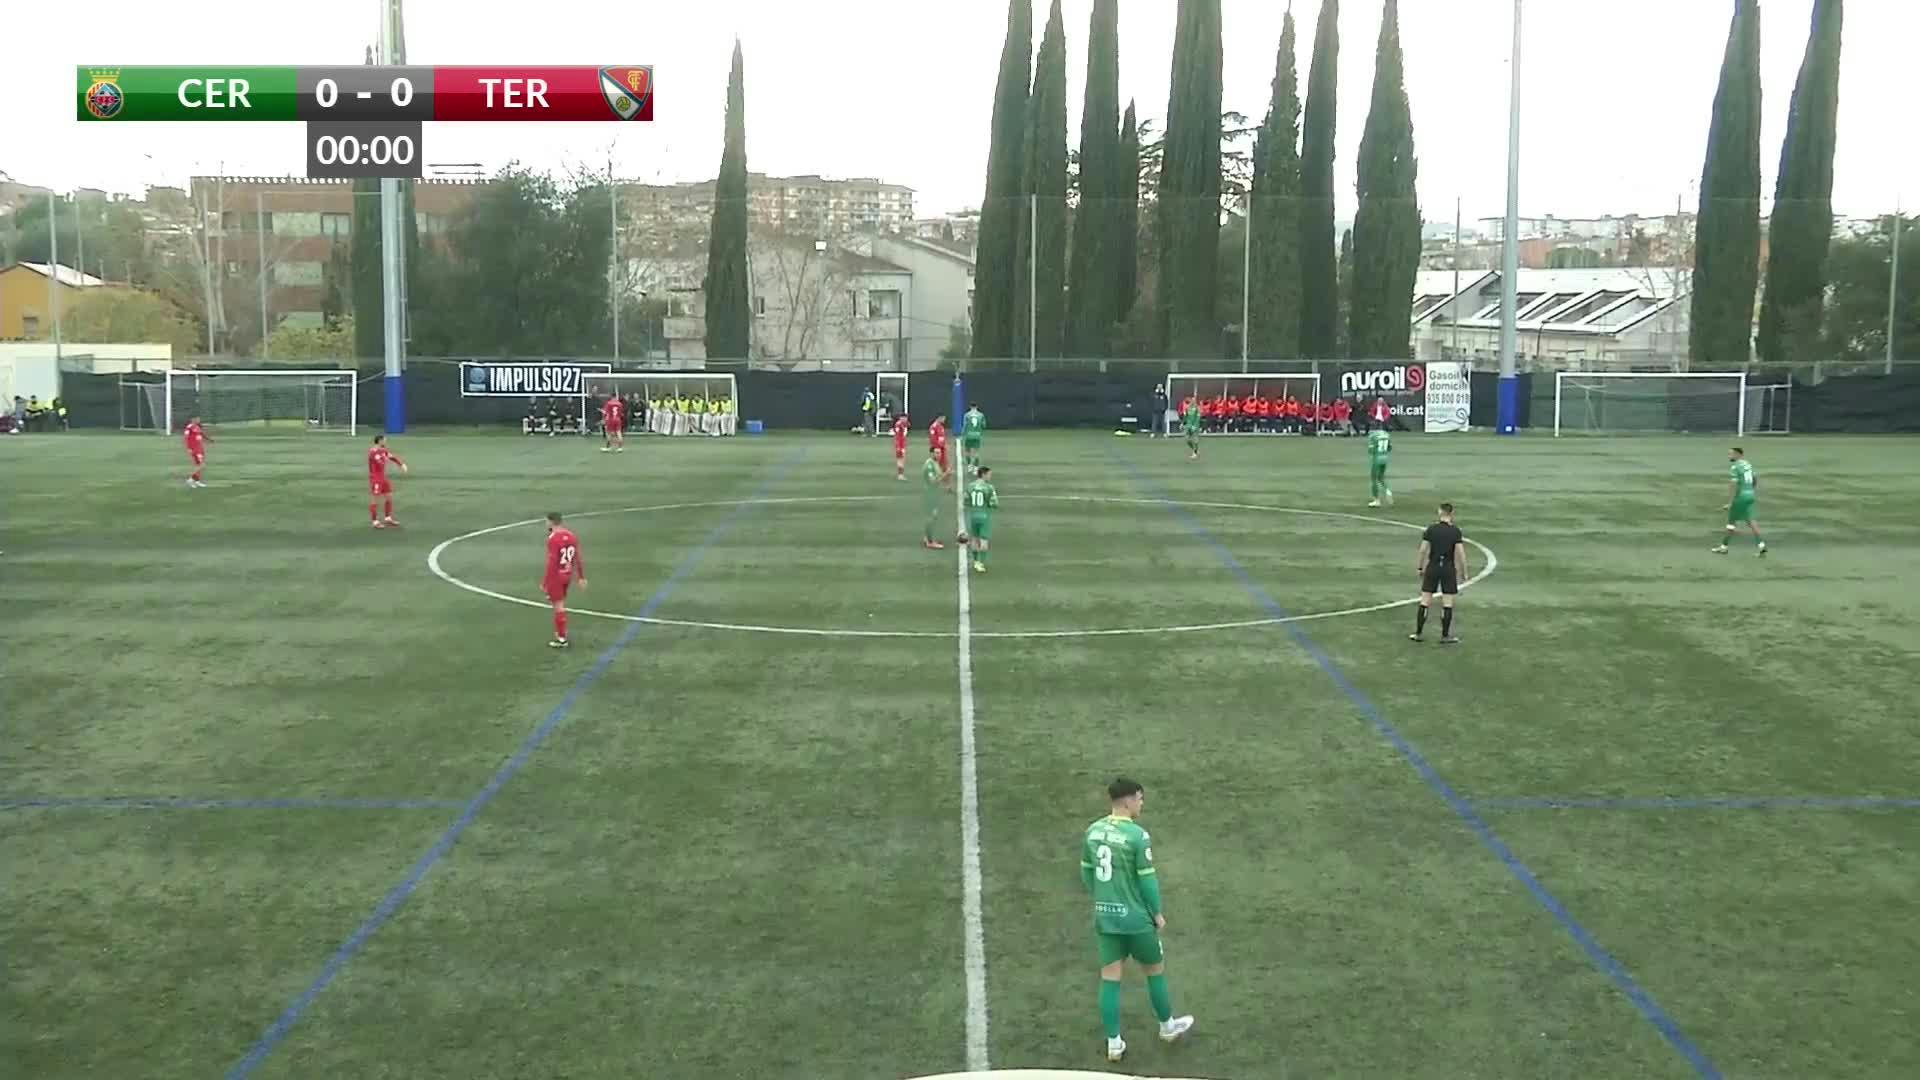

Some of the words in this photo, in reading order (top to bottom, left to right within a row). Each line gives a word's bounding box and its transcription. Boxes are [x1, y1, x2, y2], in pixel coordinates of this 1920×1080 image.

[490, 367, 582, 392] IMPULSO27
[1341, 366, 1406, 391] nuroil
[1429, 370, 1460, 380] Gasoil
[1390, 404, 1424, 416] oil.cat
[971, 490, 984, 507] 10
[559, 545, 575, 565] 29
[1095, 844, 1113, 882] 3
